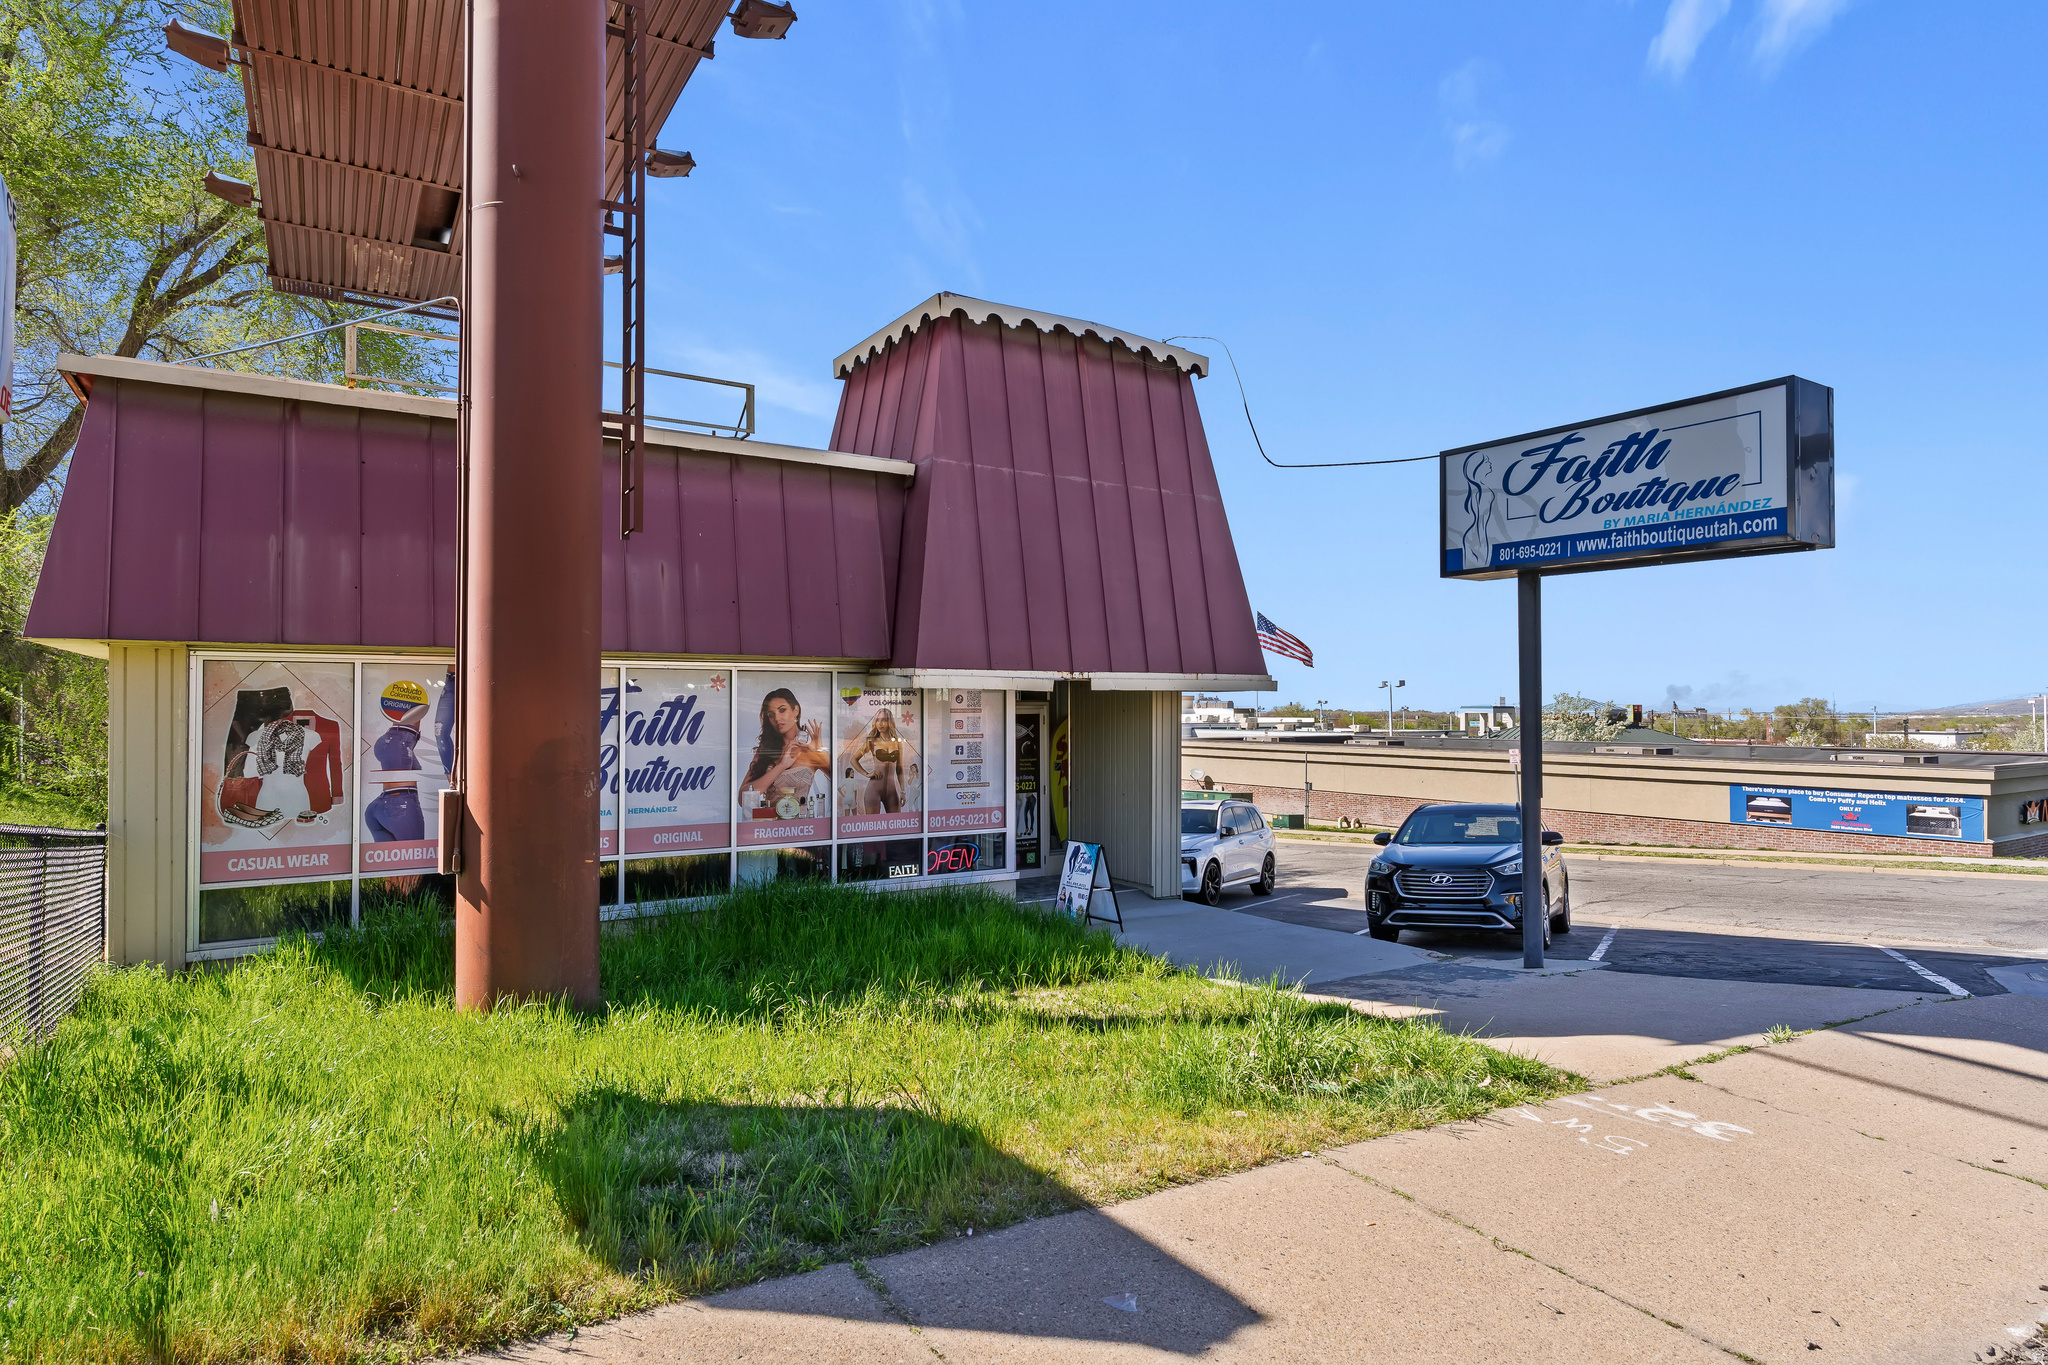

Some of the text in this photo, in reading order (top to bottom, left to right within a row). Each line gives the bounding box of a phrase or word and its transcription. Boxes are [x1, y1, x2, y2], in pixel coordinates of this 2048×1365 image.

[1502, 428, 1672, 497] Faith
[1539, 473, 1741, 524] Boutique
[1603, 497, 1773, 530] BY MARIA HERNÁNDEZ
[1499, 516, 1778, 561] 801-695-0221 www.faithboutiqueutah.com
[390, 690, 421, 702] Colombiano
[392, 684, 422, 696] Producto
[1763, 787, 1776, 795] only
[1857, 792, 1884, 800] Reports
[1884, 793, 1896, 801] top
[1838, 797, 1855, 805] Puffy
[627, 806, 678, 815] HERNÁNDEZ
[840, 817, 919, 833] COLOMBIAN GIRDLES
[929, 813, 989, 828] 801-695-0221
[653, 831, 703, 845] ORIGINAL
[754, 825, 815, 839] FRAGRANCES
[227, 853, 329, 872] CASUAL WEAR
[365, 847, 439, 864] COLOMBIA
[927, 848, 974, 872] OPEN
[888, 864, 919, 876] FAITH
